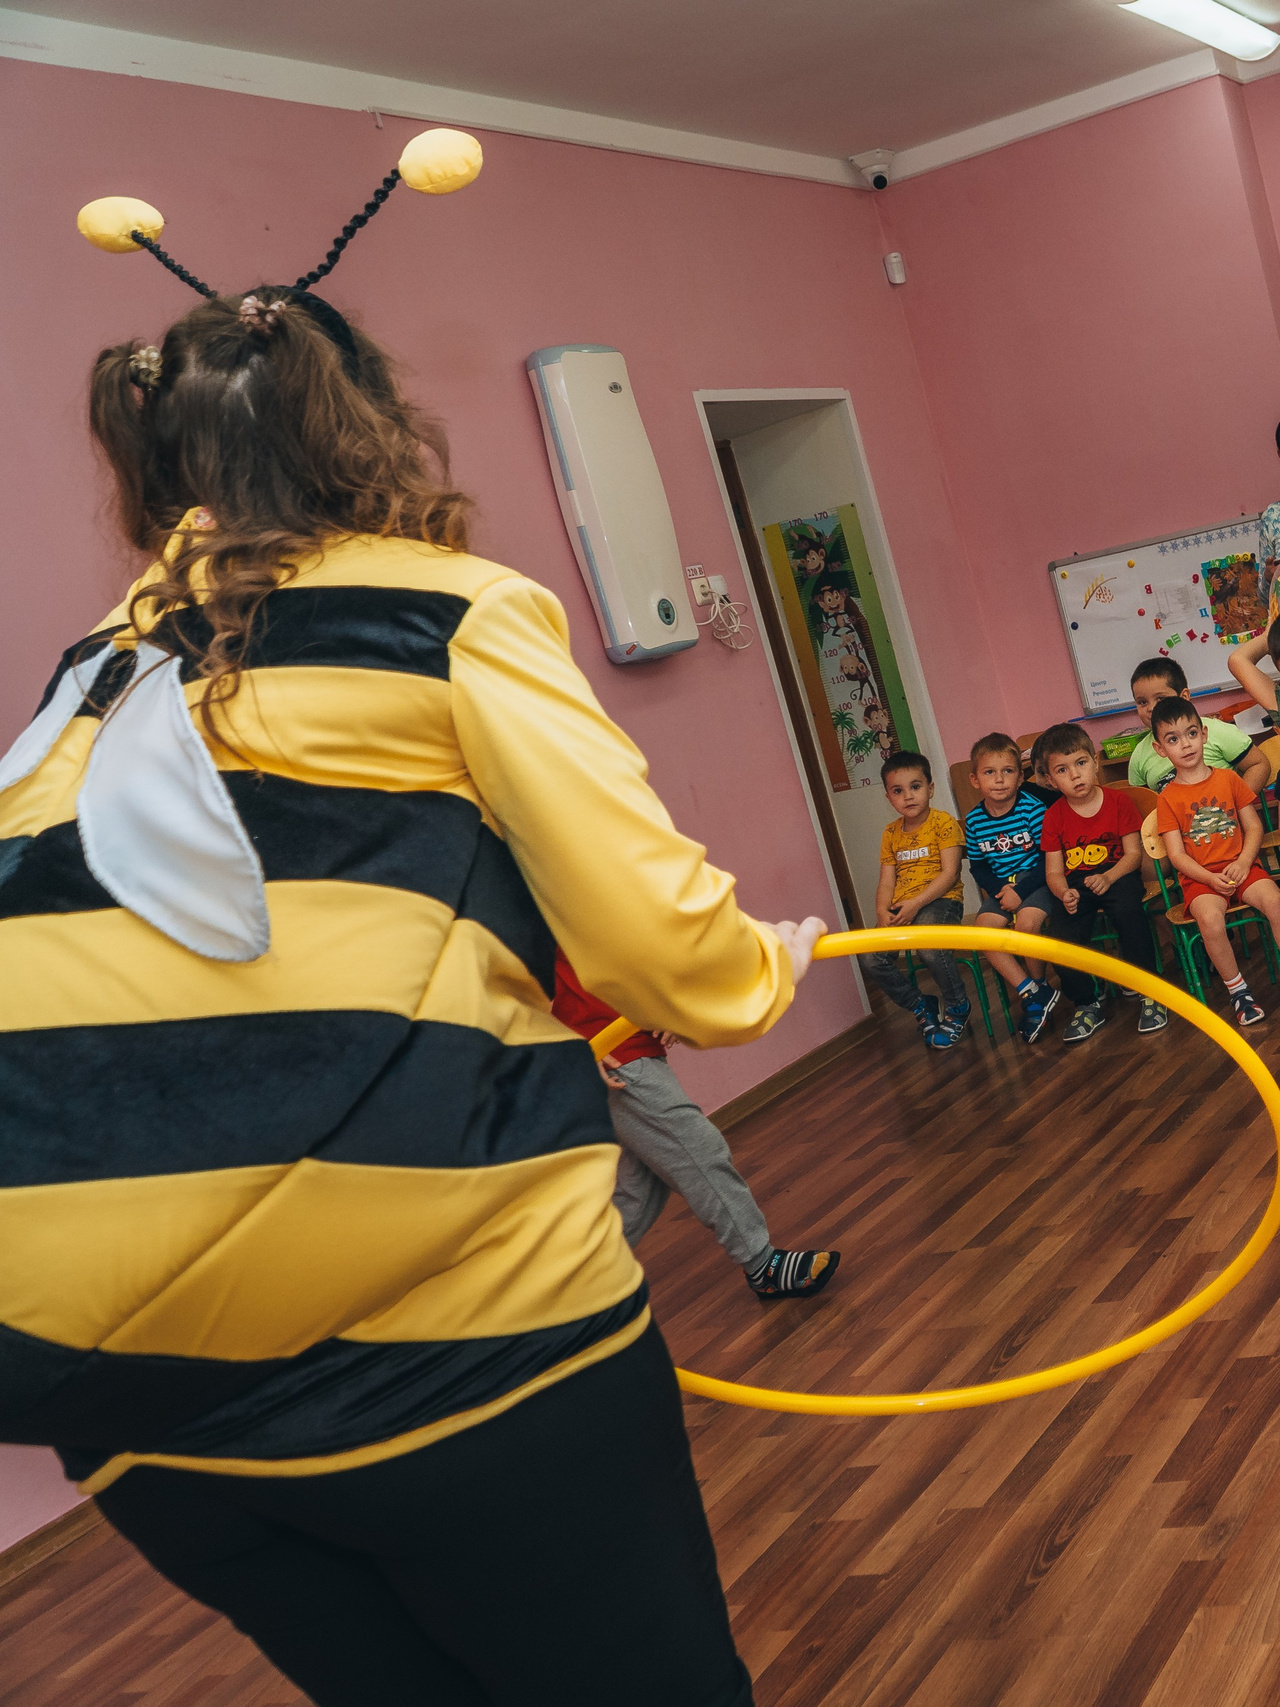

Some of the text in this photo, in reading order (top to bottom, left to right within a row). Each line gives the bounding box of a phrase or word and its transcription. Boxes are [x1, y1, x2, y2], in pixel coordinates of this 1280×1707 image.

[814, 511, 828, 521] 170
[788, 518, 803, 528] 170
[687, 567, 698, 577] 220
[824, 648, 838, 658] 120
[831, 675, 845, 684] 110
[838, 702, 853, 711] 100
[861, 778, 871, 786] 70
